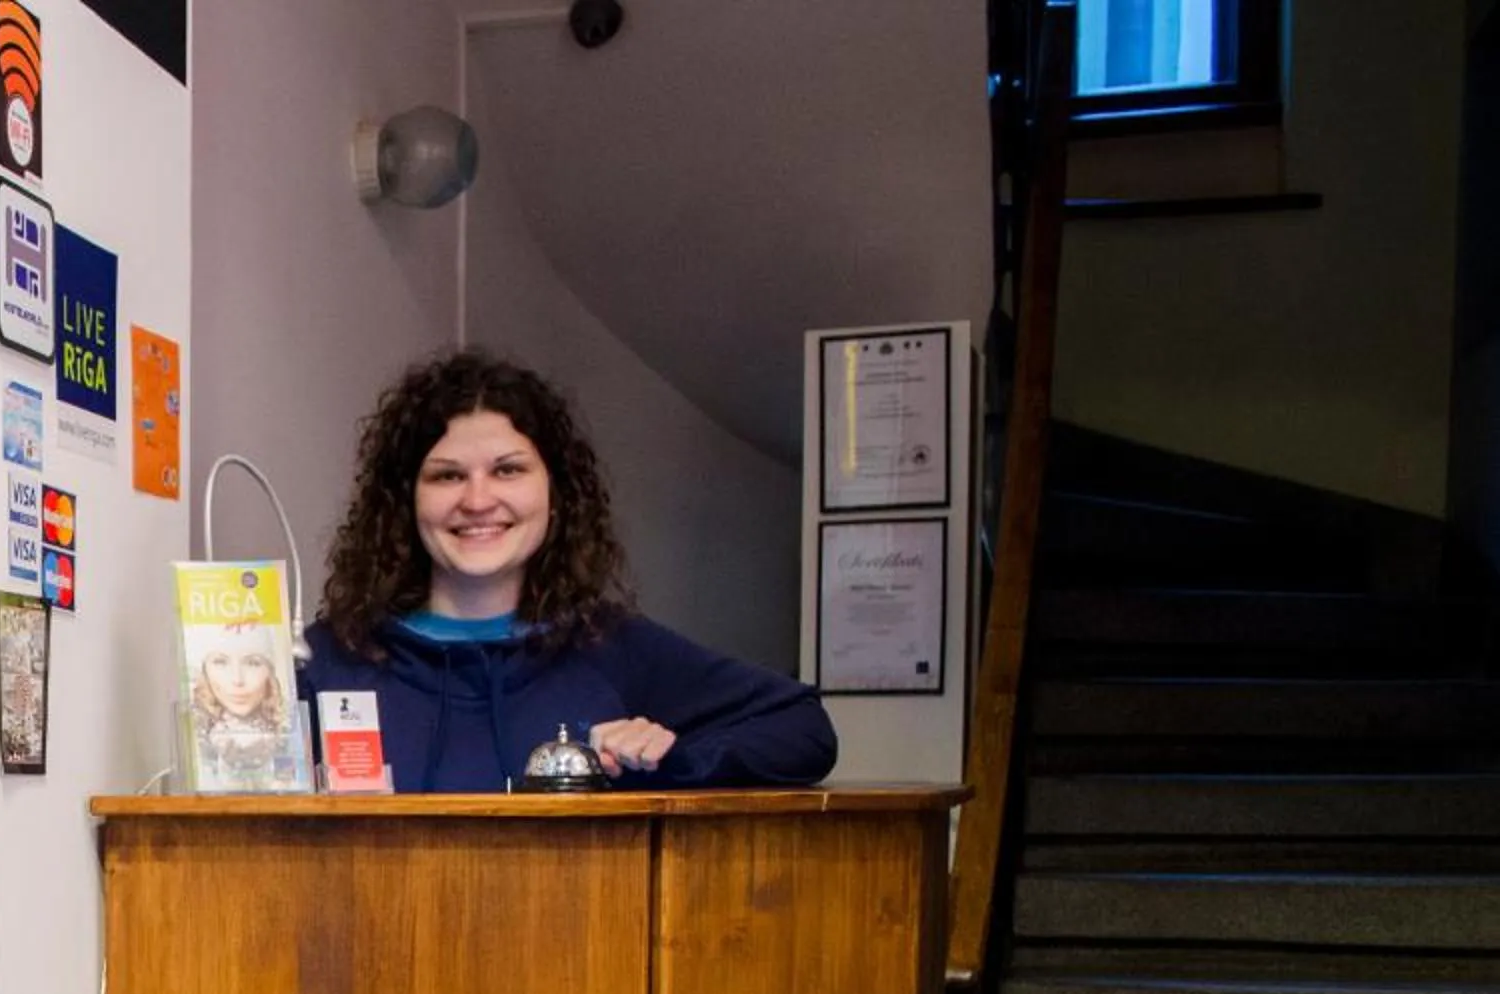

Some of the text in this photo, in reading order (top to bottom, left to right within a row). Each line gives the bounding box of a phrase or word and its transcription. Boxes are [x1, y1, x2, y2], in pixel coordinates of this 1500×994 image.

[62, 293, 105, 346] LIVE
[13, 481, 37, 509] VISA
[13, 538, 37, 564] VISA
[189, 591, 265, 618] RIGA
